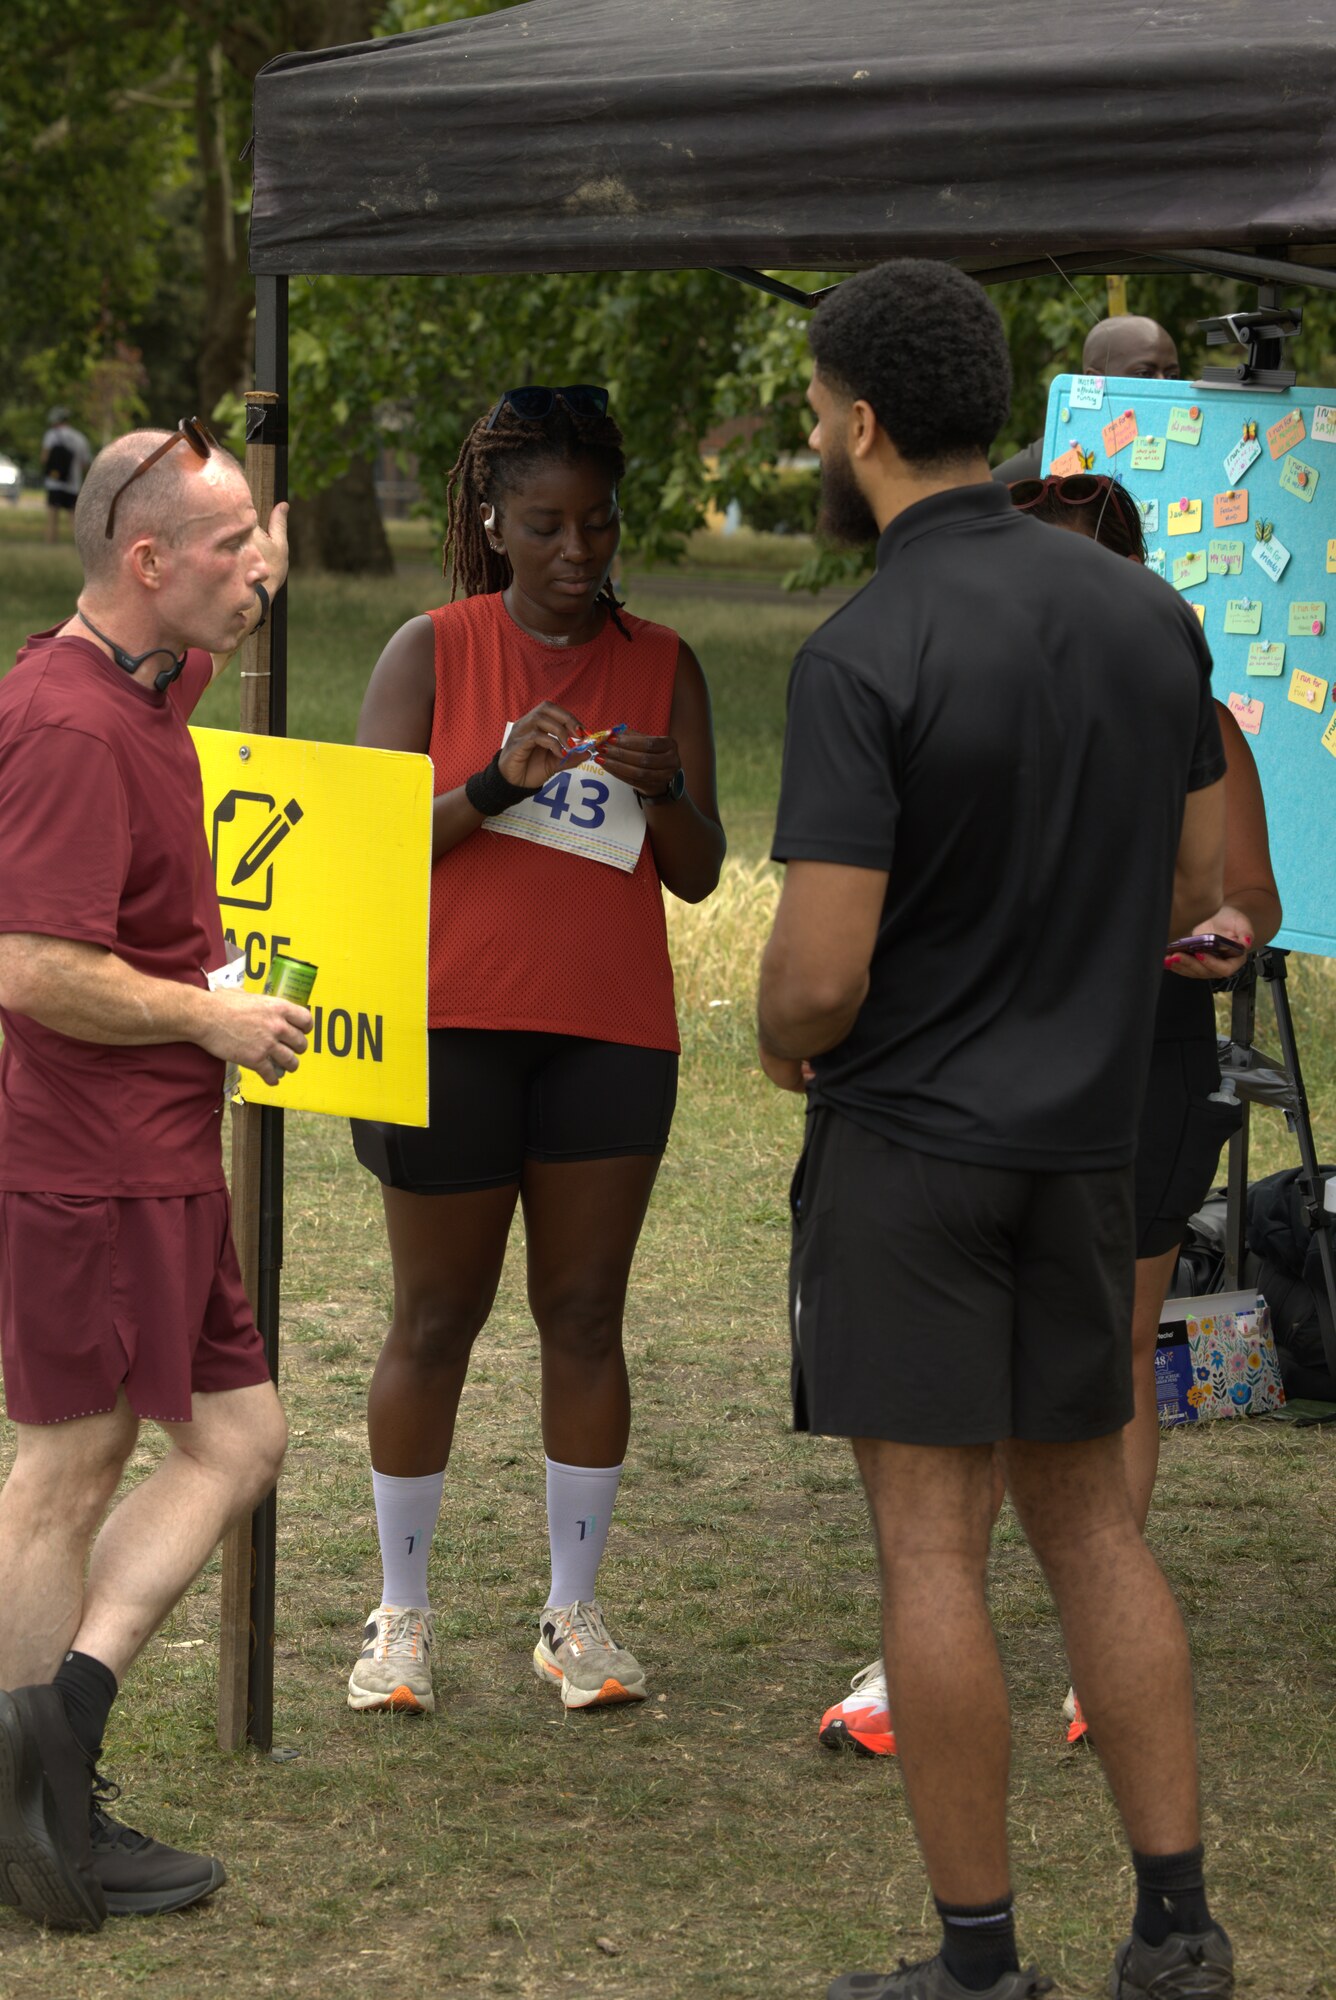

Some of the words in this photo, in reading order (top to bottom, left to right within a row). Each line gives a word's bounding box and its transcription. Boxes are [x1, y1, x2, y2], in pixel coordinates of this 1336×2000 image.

[1229, 542, 1237, 551] for
[1300, 674, 1311, 684] run
[1312, 677, 1322, 688] for
[577, 762, 605, 776] NING
[532, 771, 610, 829] 43
[307, 1005, 383, 1063] ION
